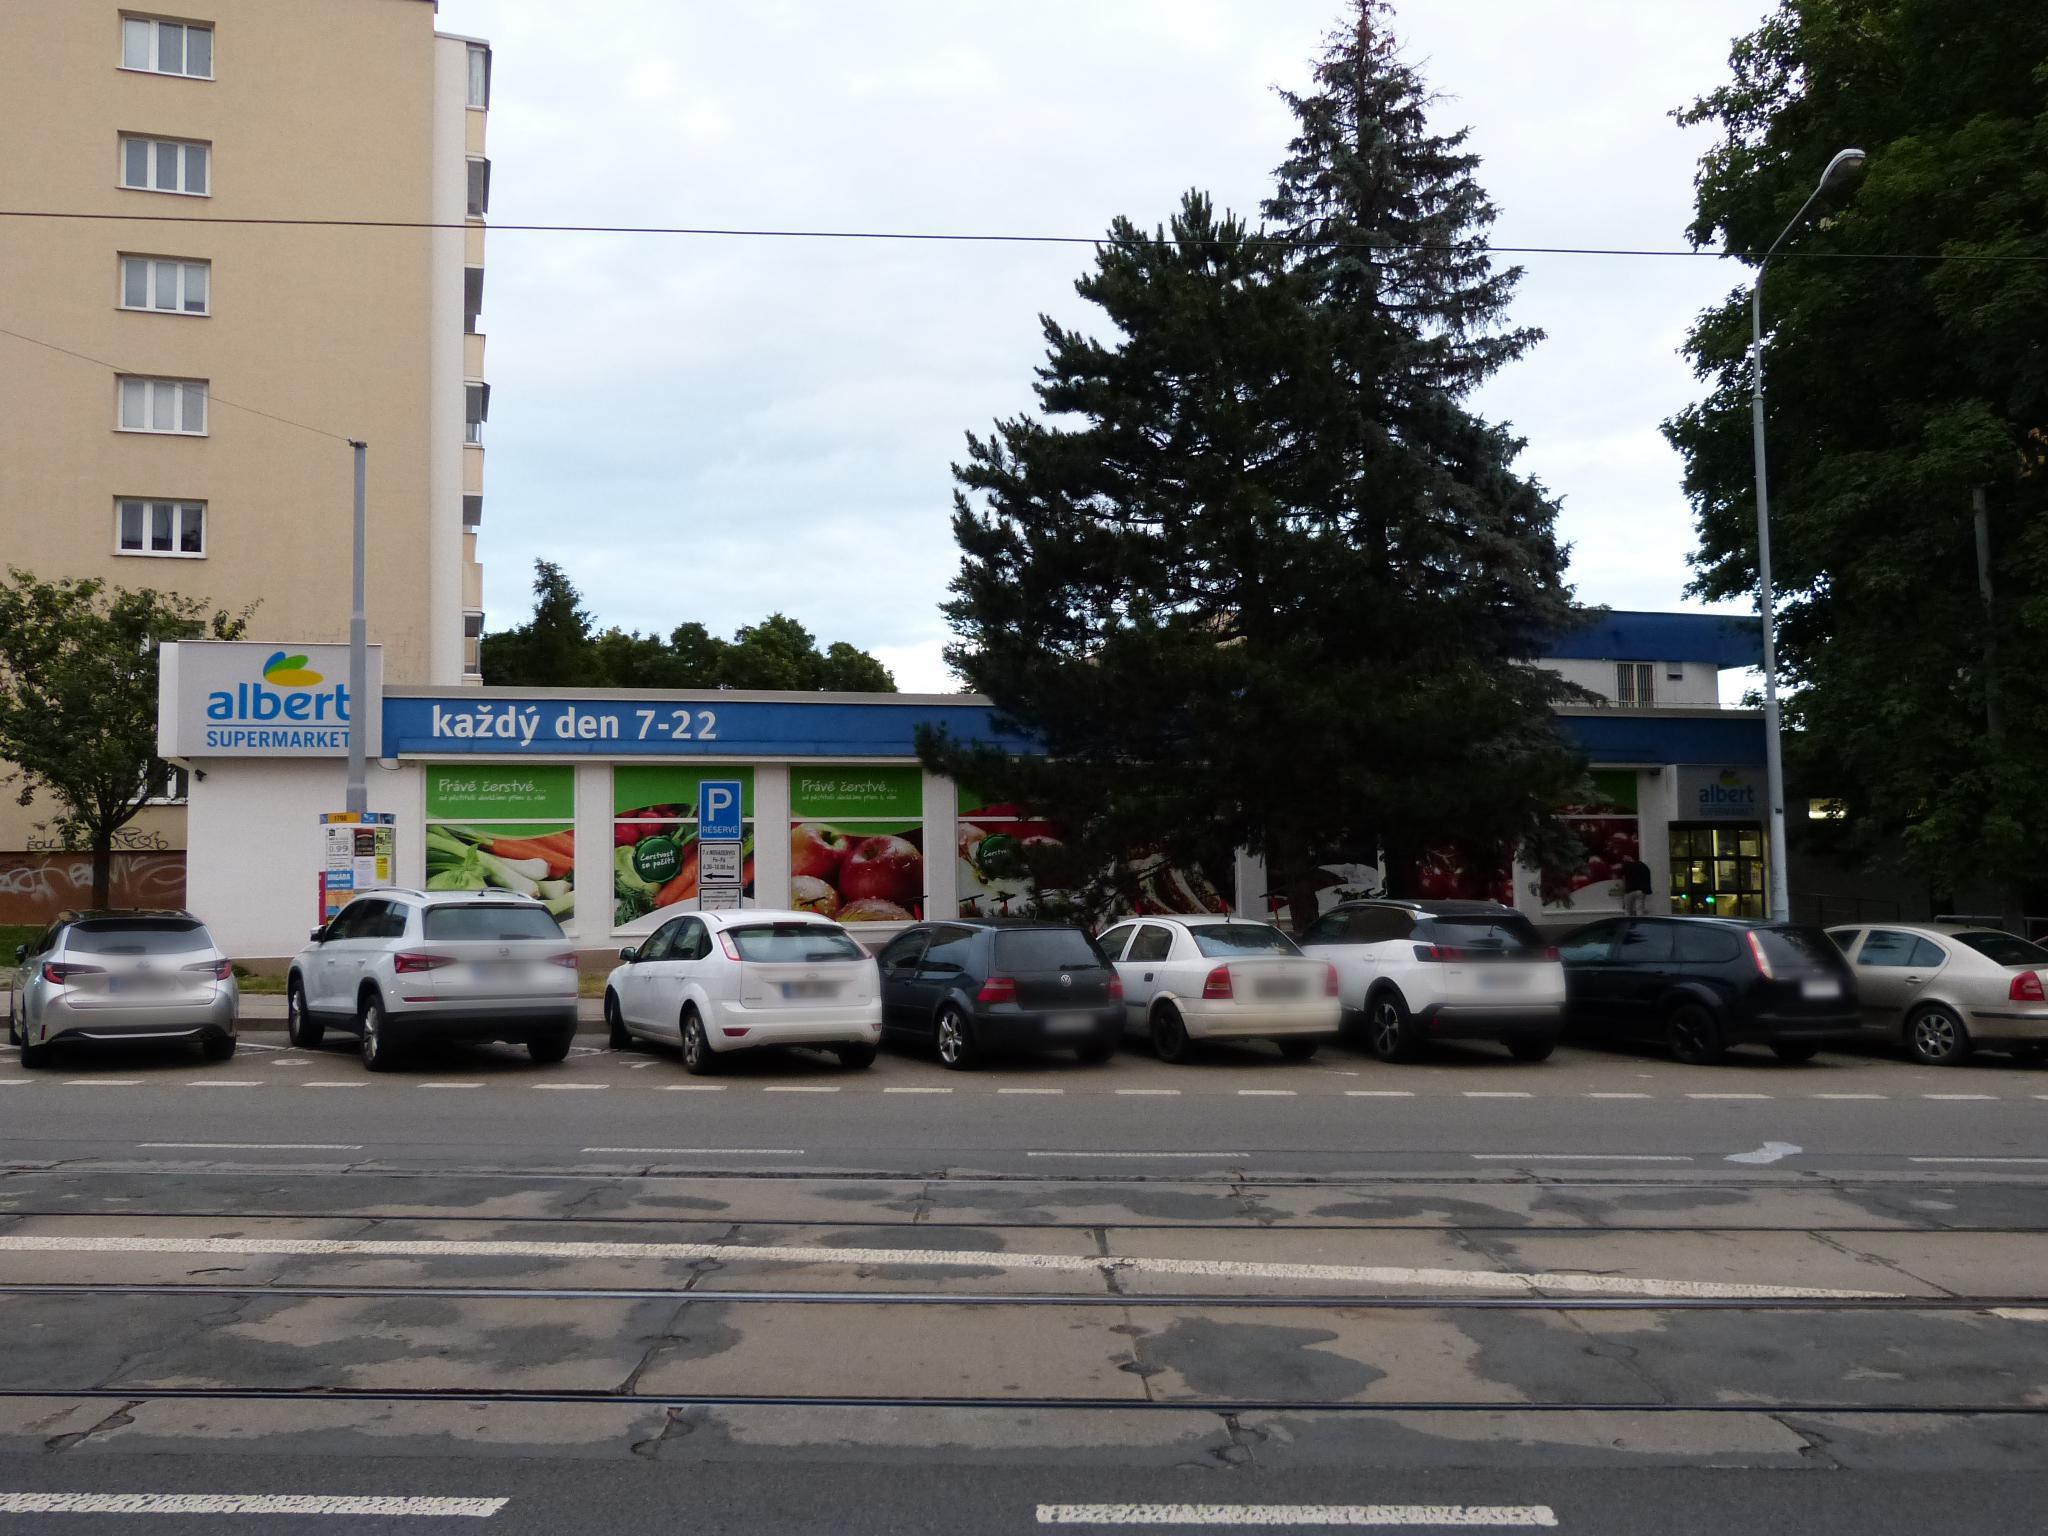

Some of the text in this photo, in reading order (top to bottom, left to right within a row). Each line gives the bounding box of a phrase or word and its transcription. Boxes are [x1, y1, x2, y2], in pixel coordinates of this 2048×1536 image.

[207, 682, 351, 721] albert
[206, 730, 350, 748] SUPERMARKET
[432, 704, 718, 747] každý den 7-22
[708, 788, 732, 821] P
[1699, 784, 1754, 803] albert
